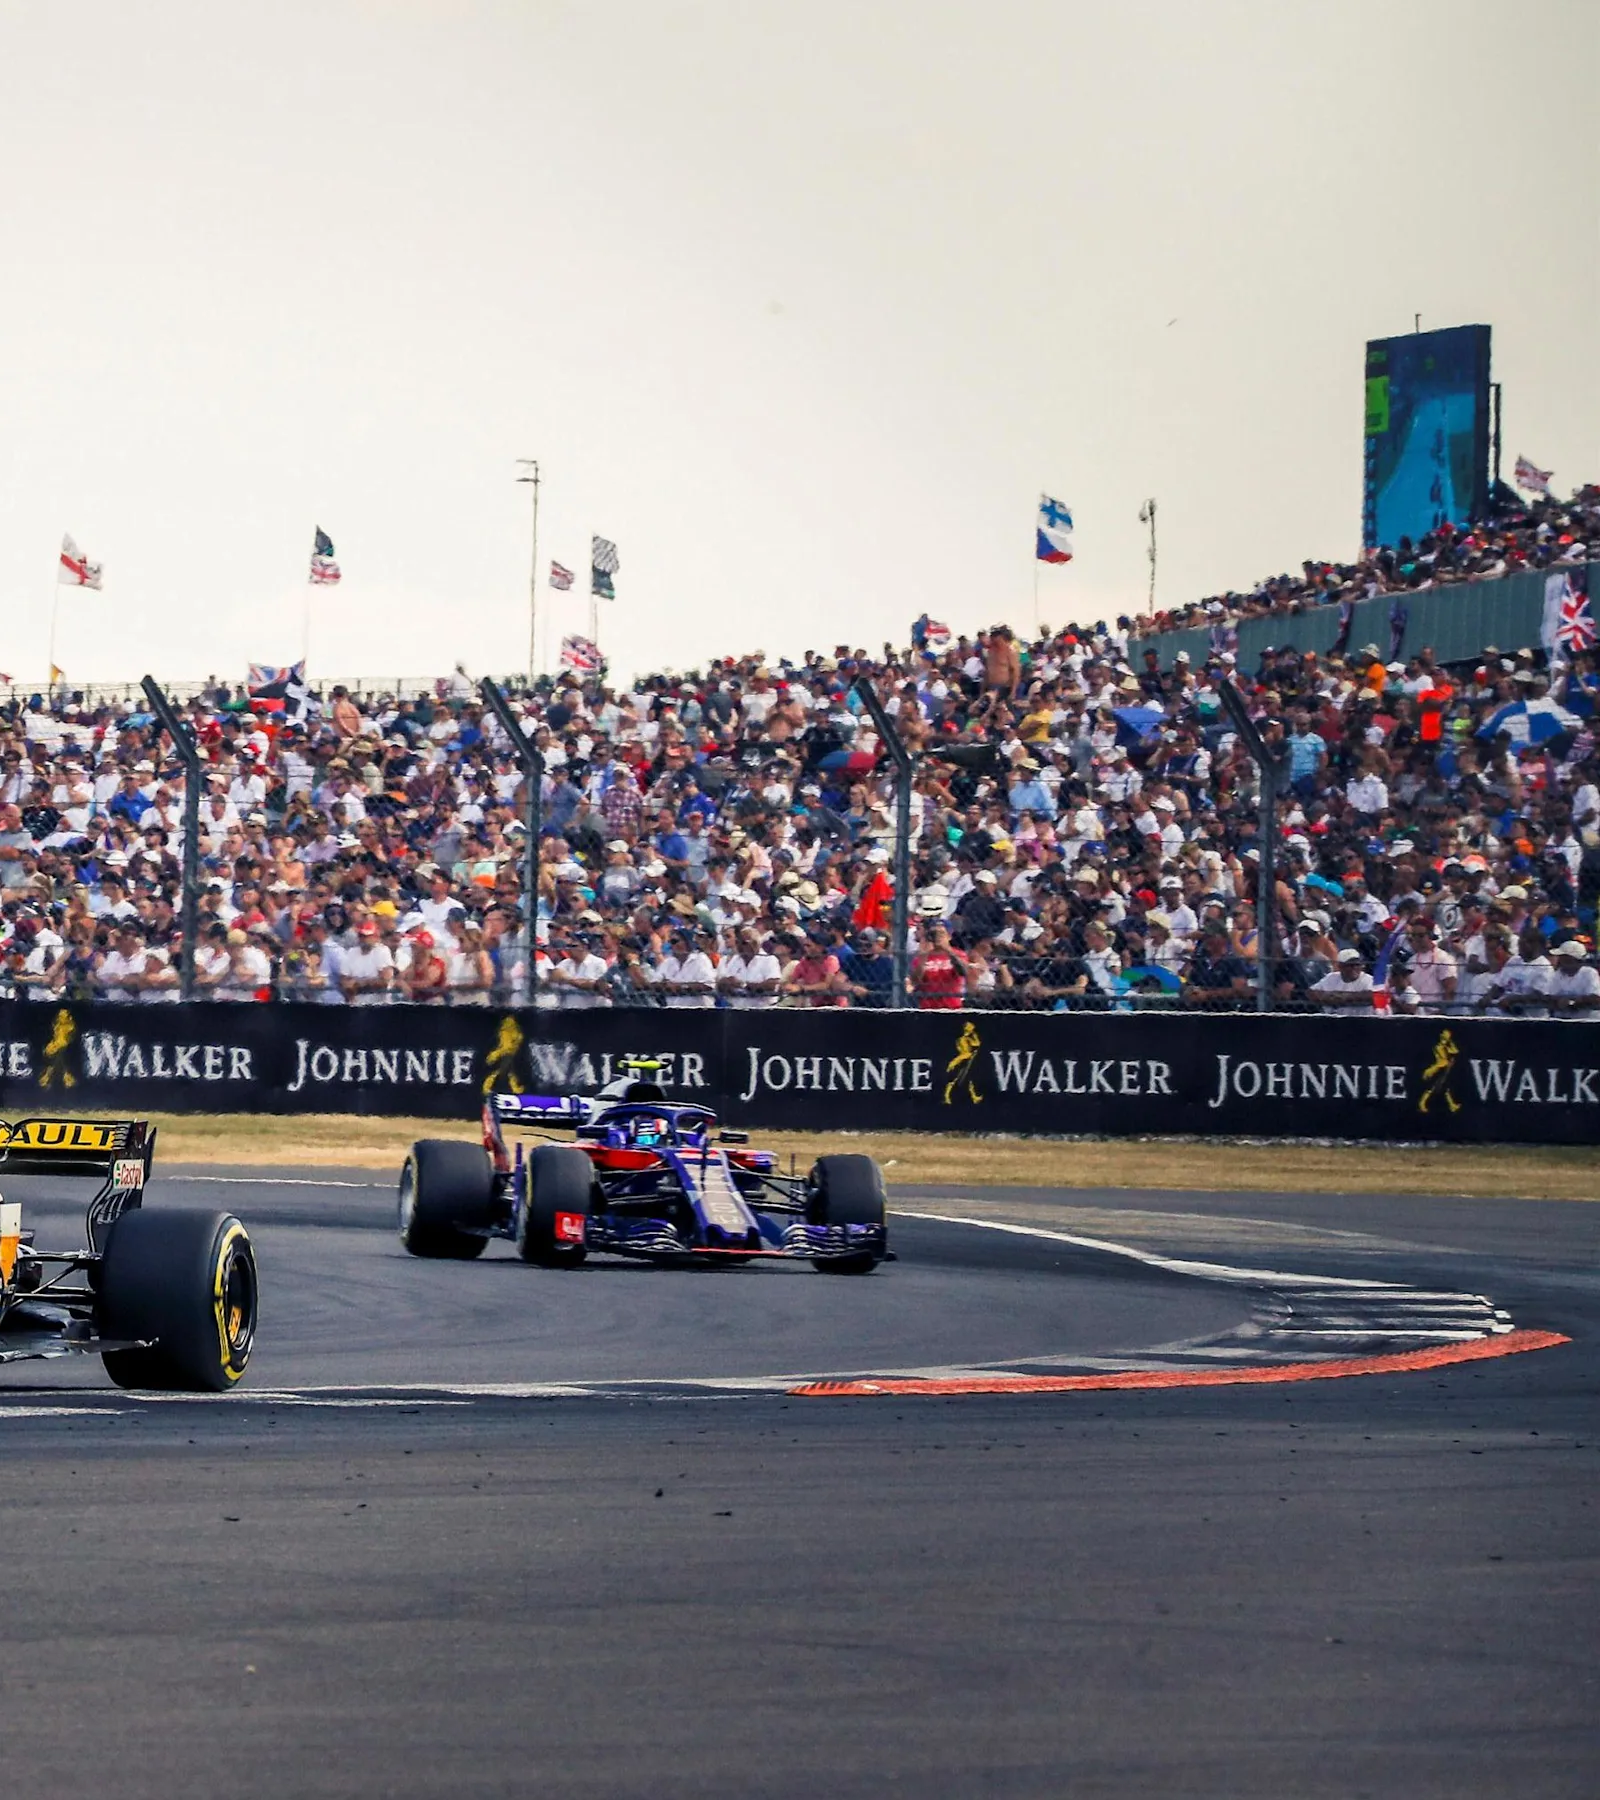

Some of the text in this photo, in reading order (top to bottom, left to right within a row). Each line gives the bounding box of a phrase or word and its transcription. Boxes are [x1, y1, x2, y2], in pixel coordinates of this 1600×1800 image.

[81, 1032, 253, 1080] WALKER
[286, 1039, 475, 1092] JOHNNIE
[740, 1047, 1173, 1099] JOHNNIE WALKER
[1207, 1054, 1600, 1107] JOHNNIE WALK
